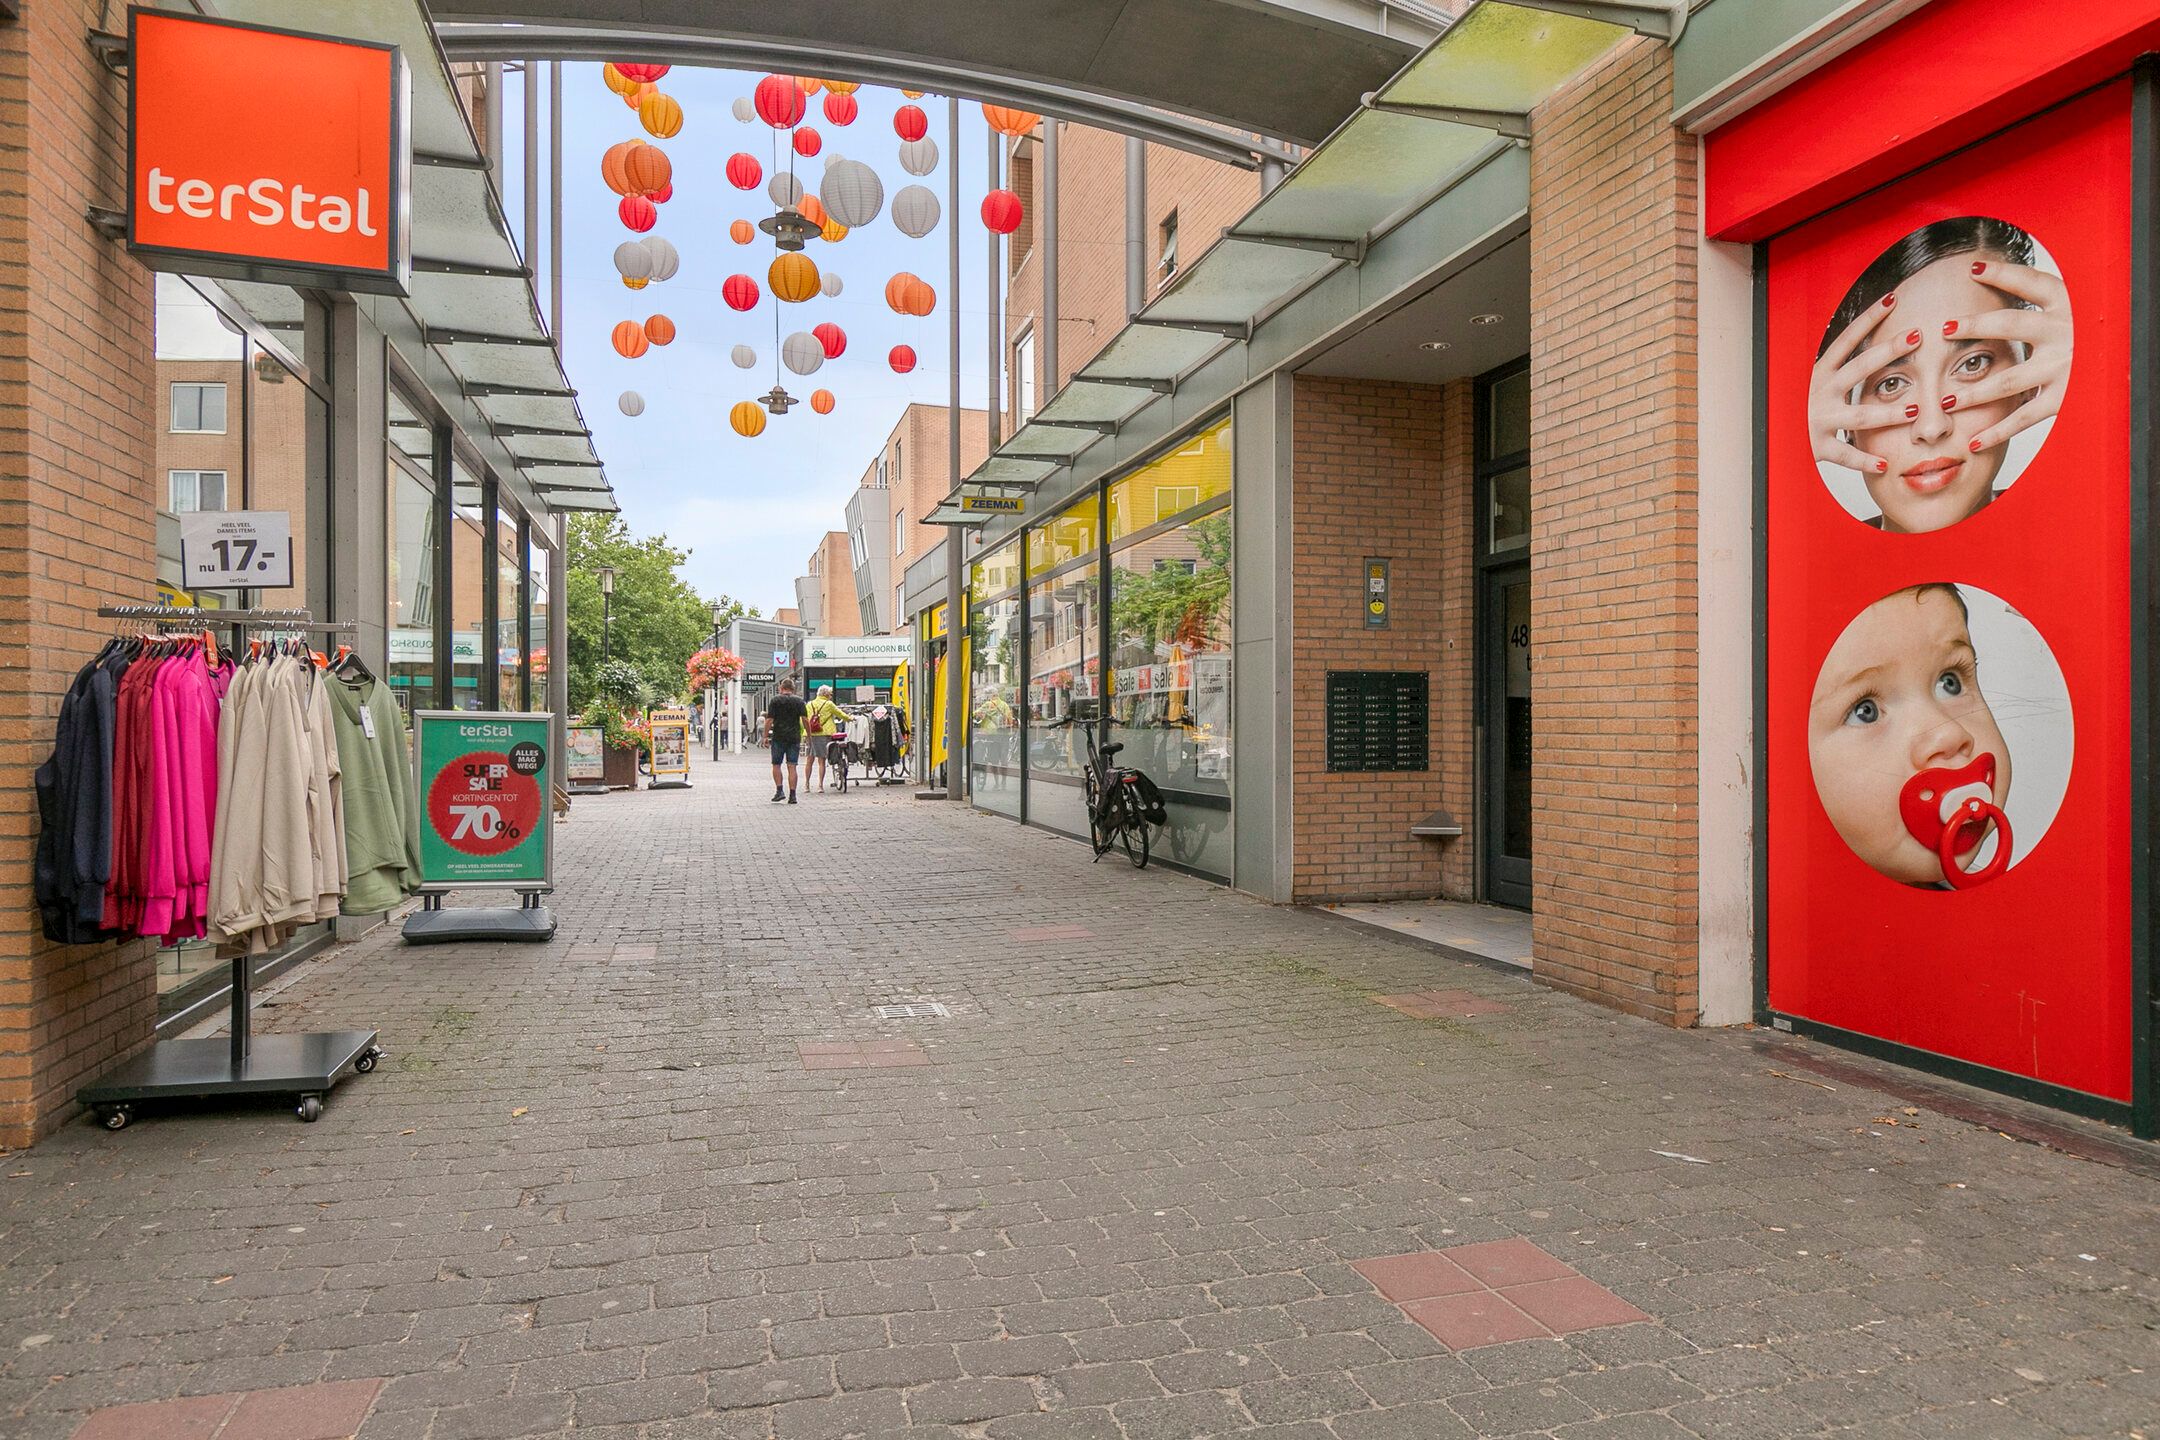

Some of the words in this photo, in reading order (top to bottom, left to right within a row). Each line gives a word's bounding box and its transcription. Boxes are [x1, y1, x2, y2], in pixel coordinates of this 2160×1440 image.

[148, 167, 377, 237] terStal
[971, 500, 1018, 510] ZEEMAN
[199, 564, 215, 572] nu
[847, 645, 897, 653] OUDSHOORN
[1118, 673, 1135, 693] sale
[1154, 670, 1174, 689] sale
[460, 725, 513, 737] terStal
[464, 764, 508, 777] SUPER
[469, 778, 503, 791] SALE
[452, 793, 500, 802] KORTINGEN
[502, 793, 518, 802] TOT
[449, 805, 520, 840] 70%
